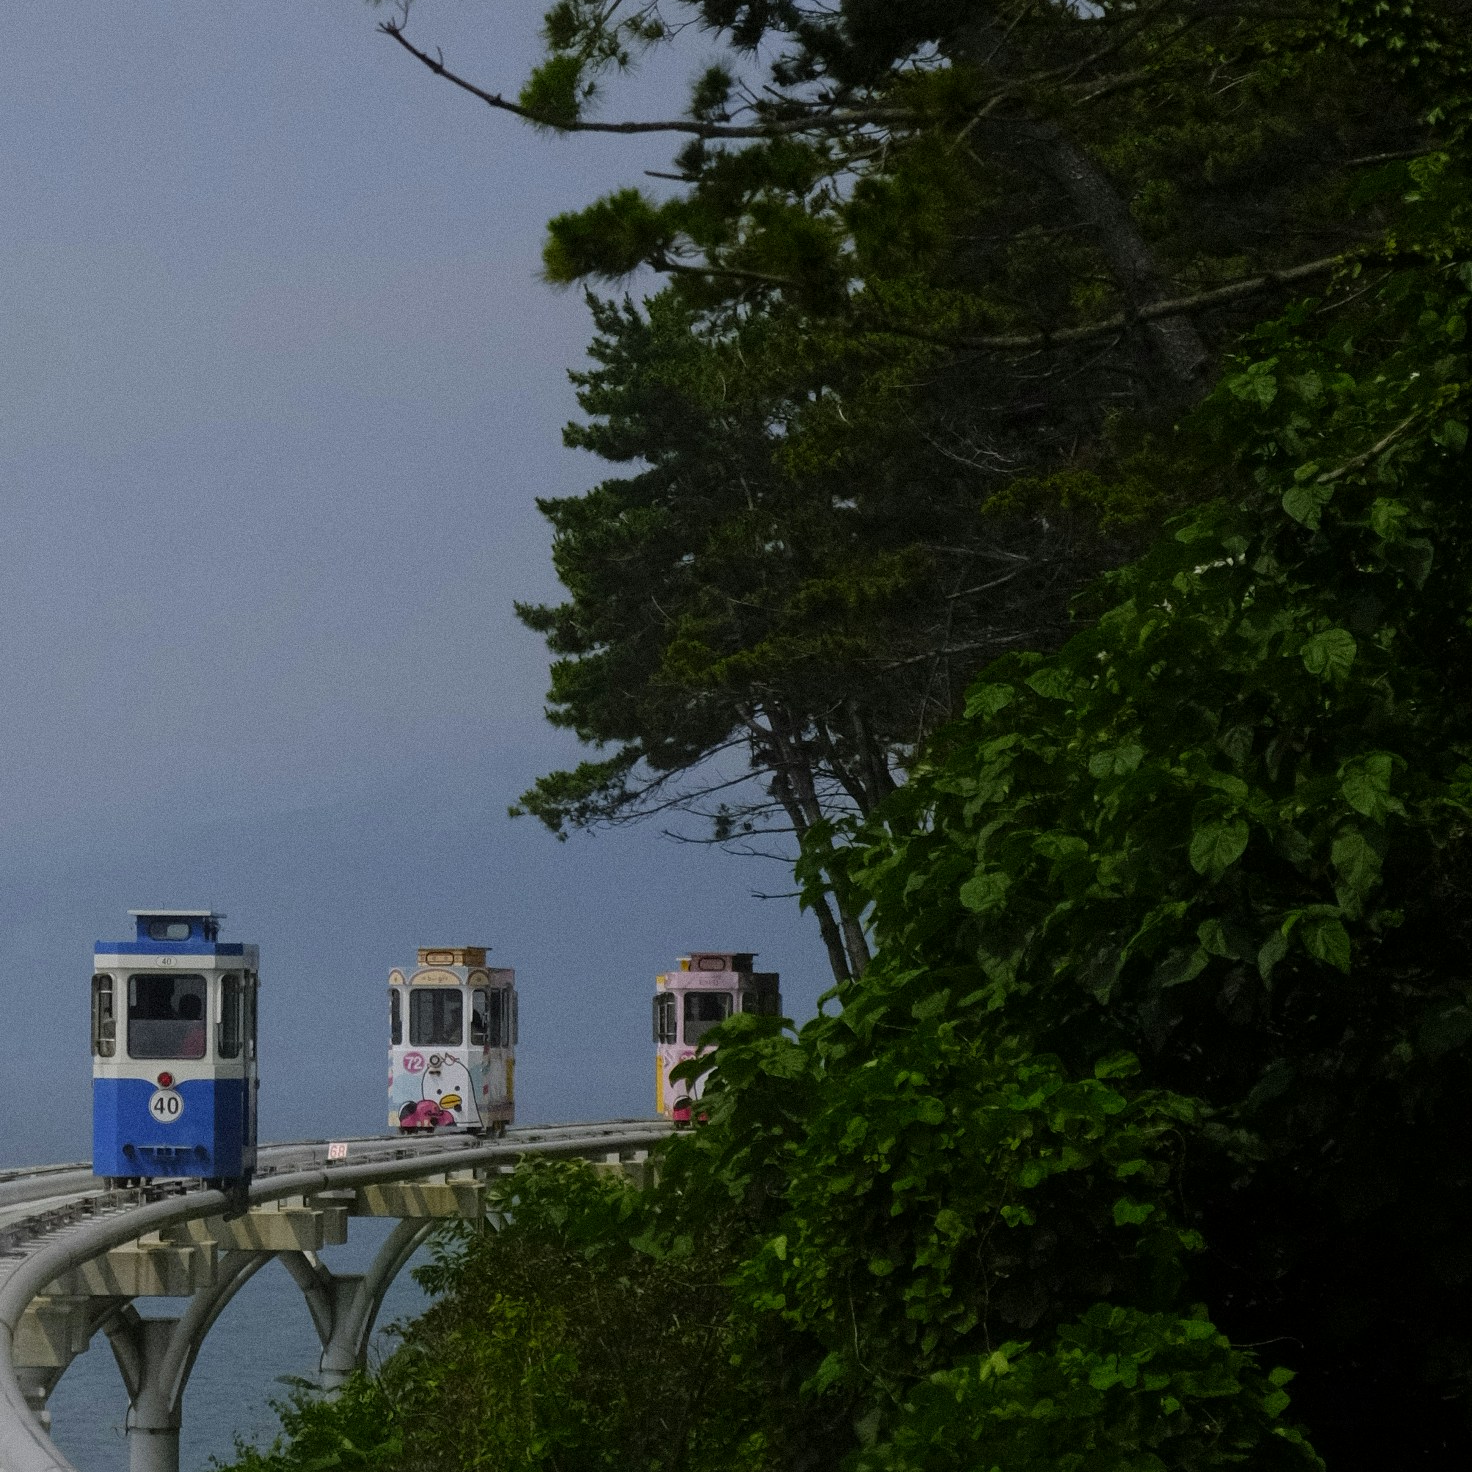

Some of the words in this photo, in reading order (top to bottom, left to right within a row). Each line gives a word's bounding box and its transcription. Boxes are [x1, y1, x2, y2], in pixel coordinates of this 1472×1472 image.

[161, 957, 171, 965] 40
[405, 1056, 423, 1070] 72
[154, 1097, 179, 1114] 40
